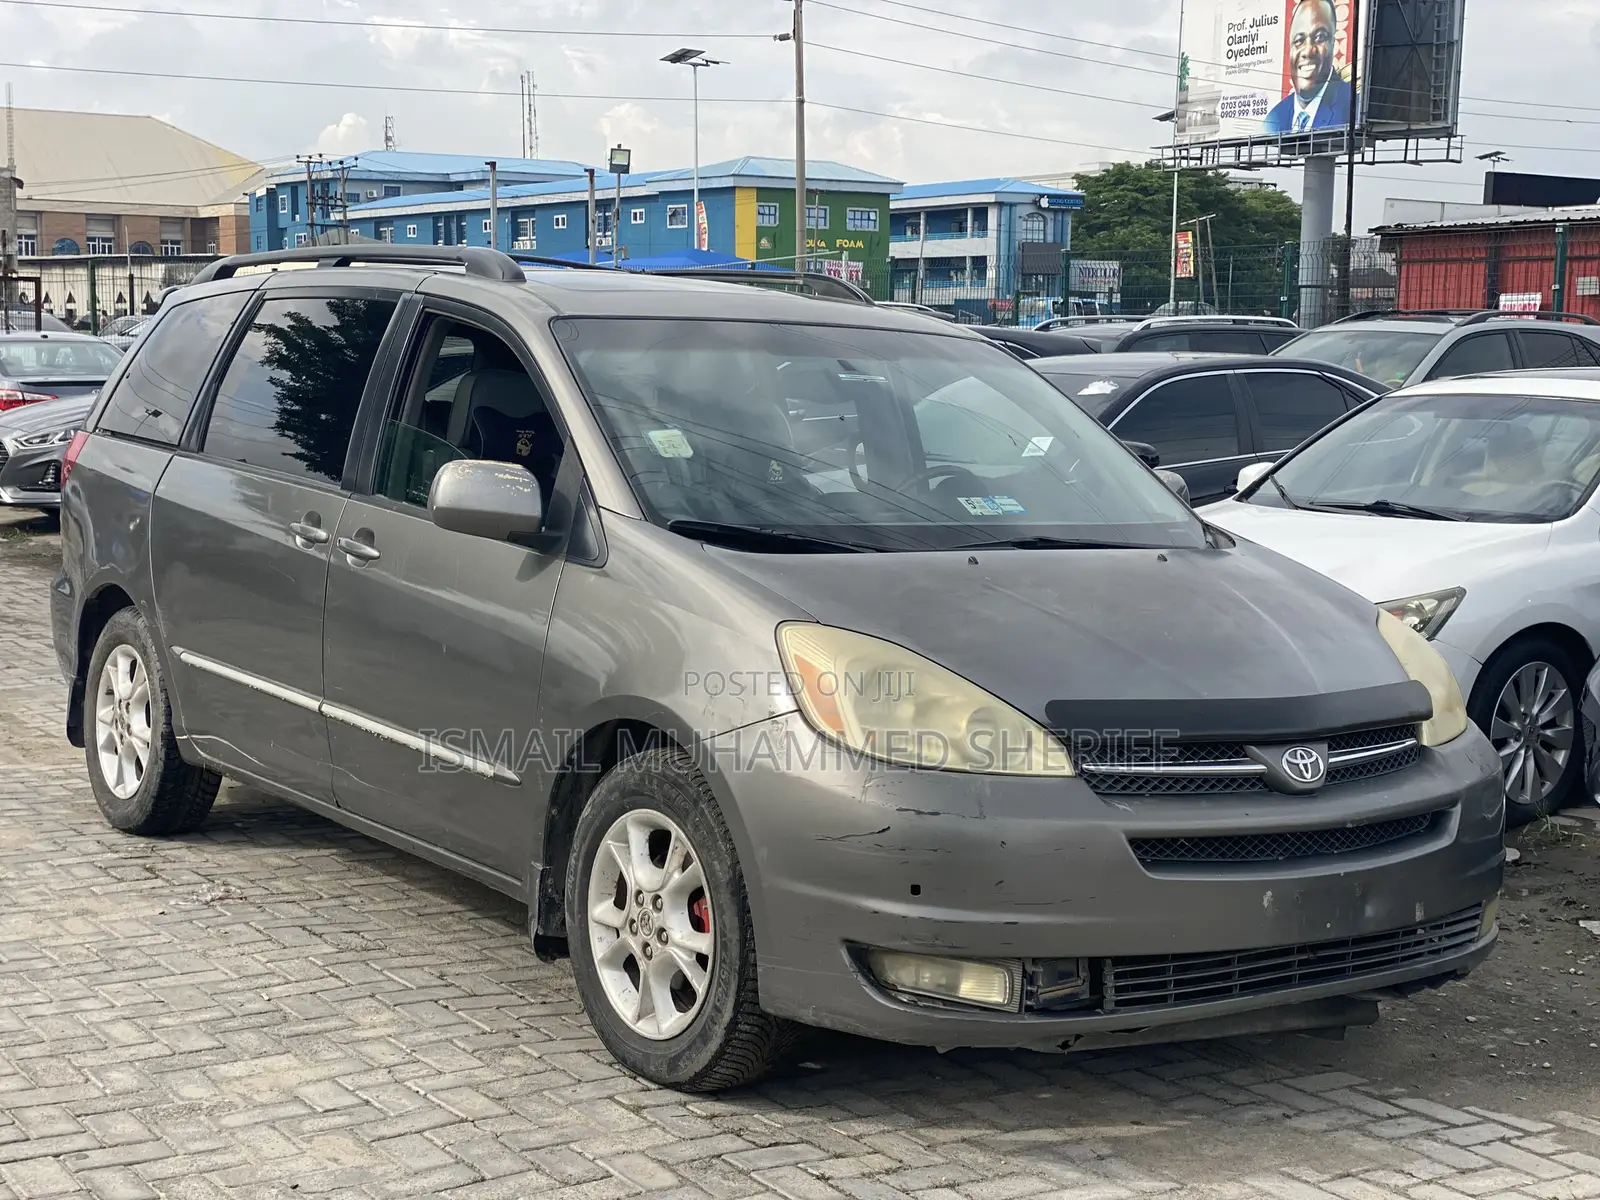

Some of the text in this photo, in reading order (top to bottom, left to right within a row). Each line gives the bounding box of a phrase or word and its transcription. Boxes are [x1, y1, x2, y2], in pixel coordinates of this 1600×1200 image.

[1227, 14, 1279, 33] Prof. Julius
[1227, 29, 1259, 46] Olaniyi
[1226, 41, 1268, 62] Oyedemi
[1220, 98, 1268, 110] 0703 044 9696
[1229, 94, 1248, 102] enquiries
[1220, 109, 1237, 119] 0909
[1237, 108, 1250, 117] 999
[805, 239, 864, 249] OUKA FOAM
